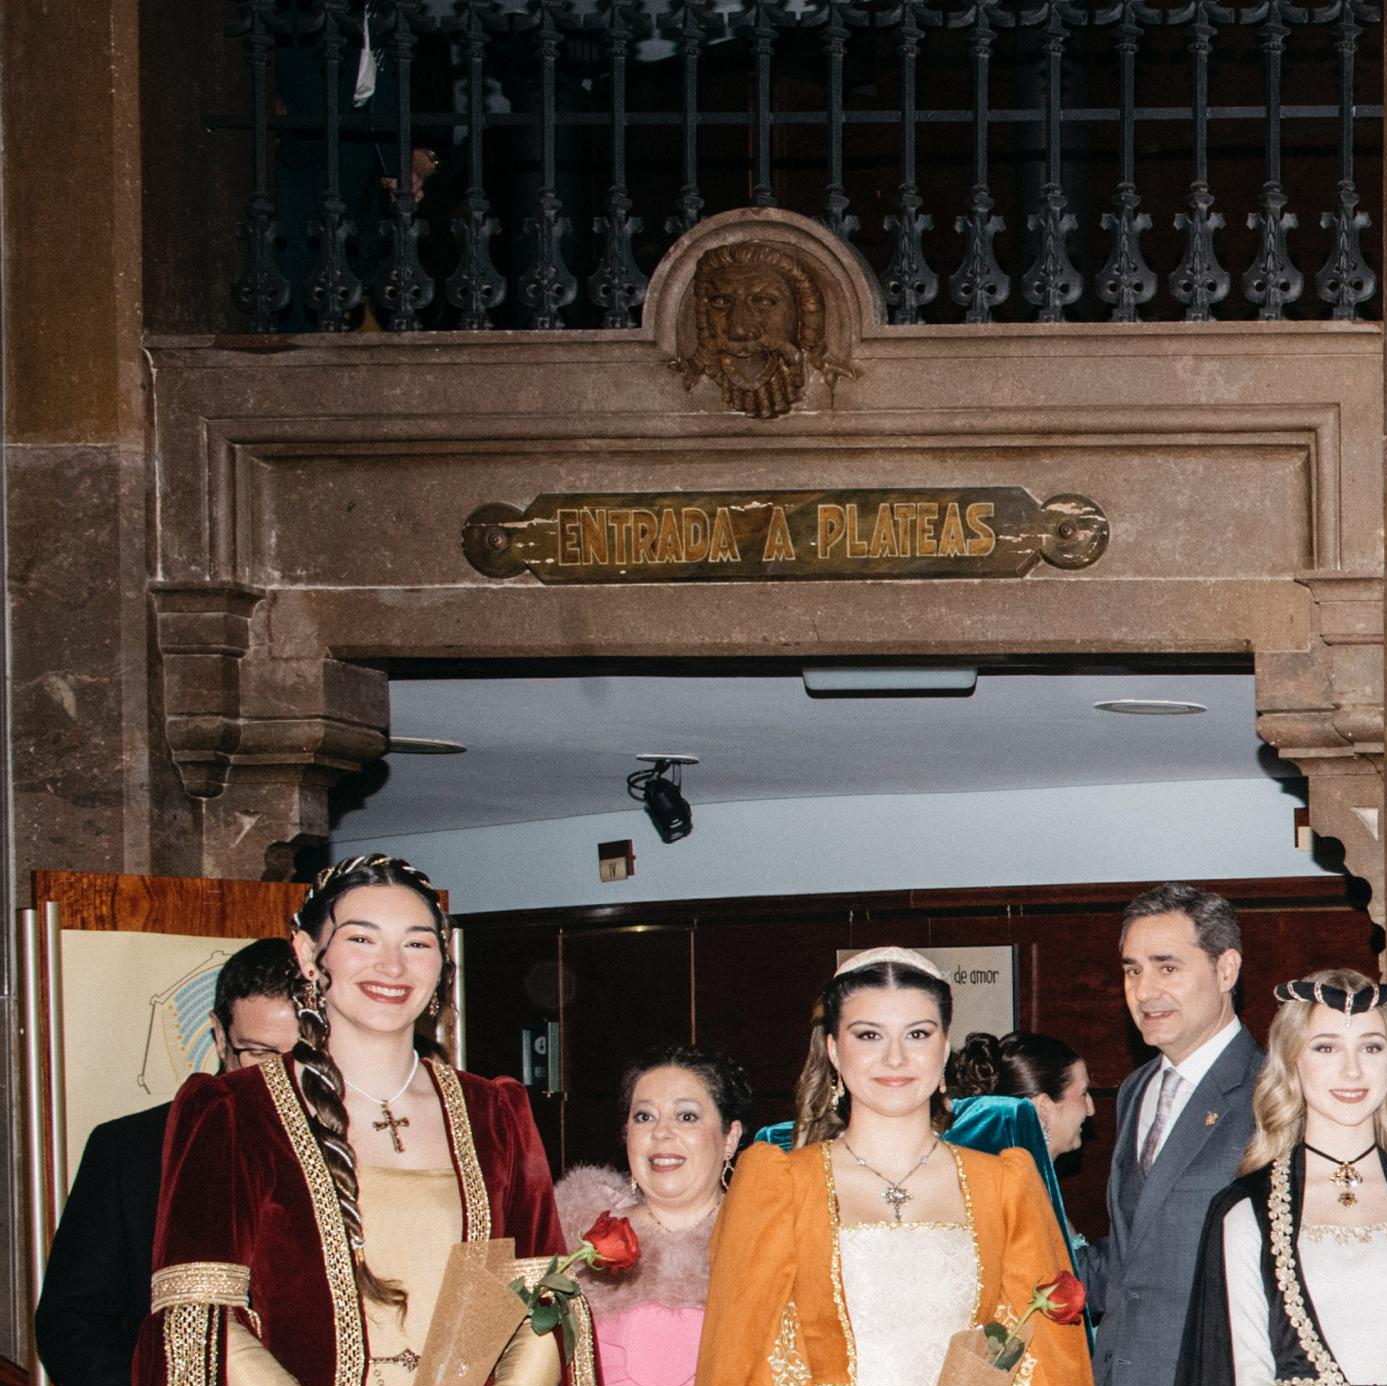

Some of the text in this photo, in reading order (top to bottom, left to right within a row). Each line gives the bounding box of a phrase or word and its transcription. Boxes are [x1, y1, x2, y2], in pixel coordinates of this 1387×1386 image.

[557, 503, 996, 566] ENTRADA A PLATEAS
[954, 964, 968, 985] de
[970, 969, 1000, 985] amor
